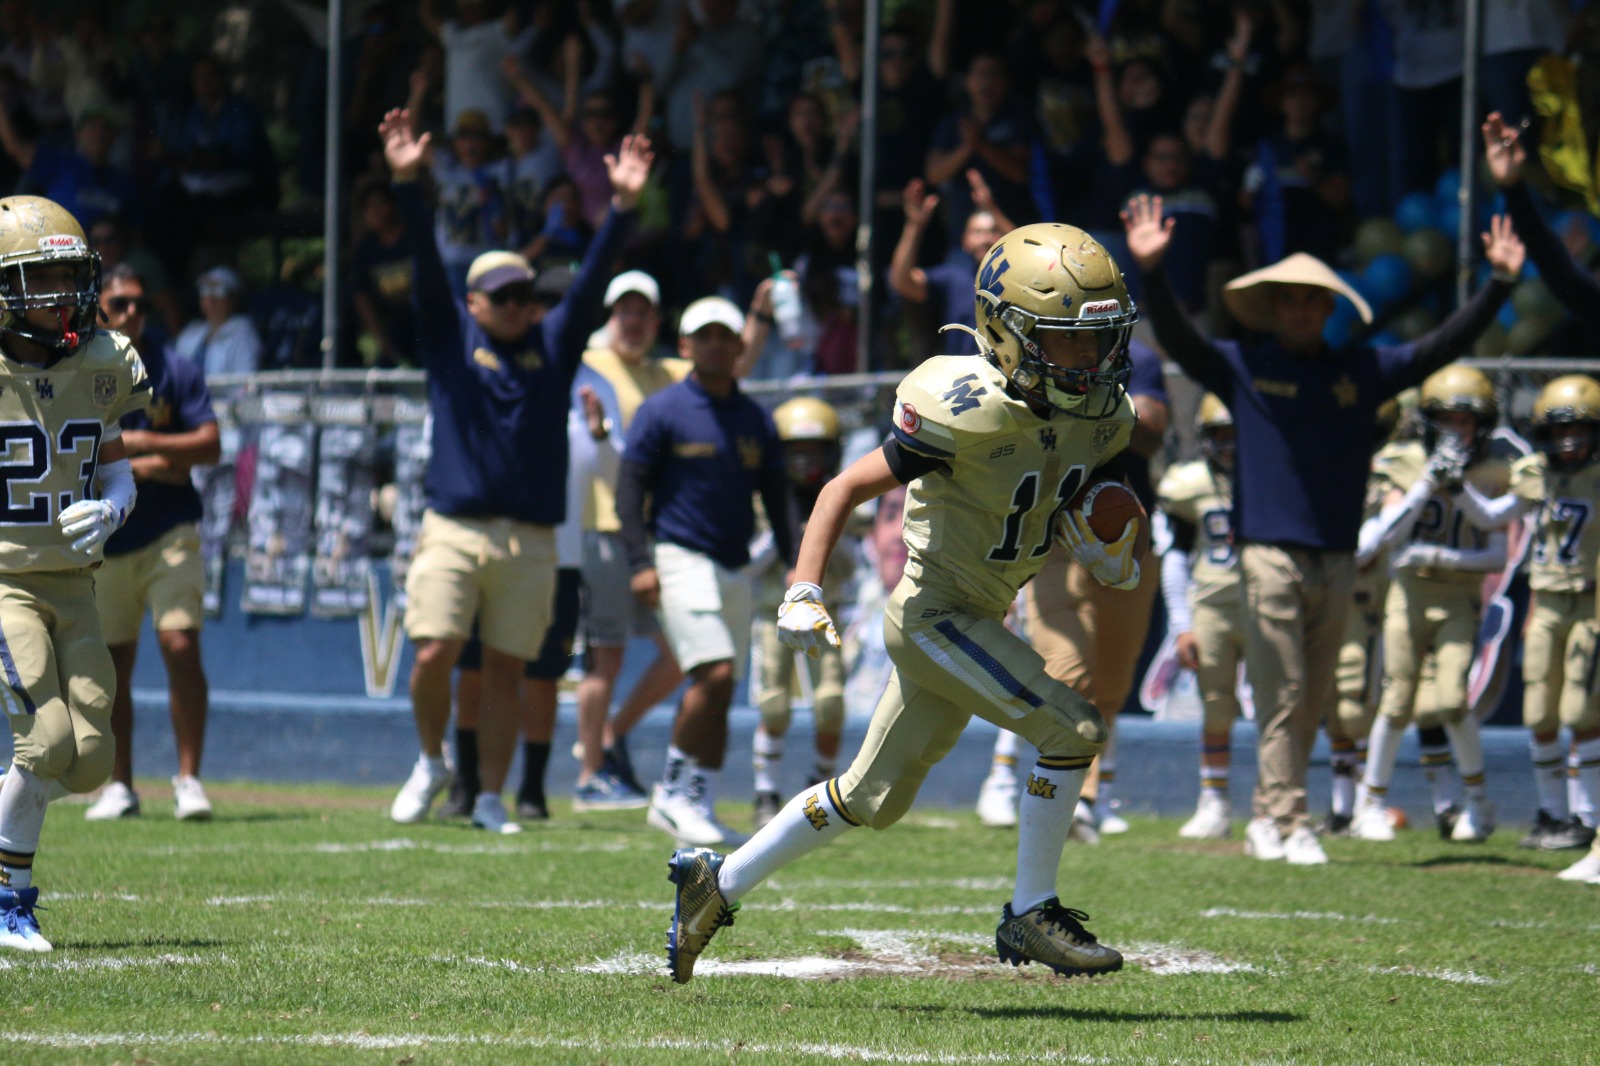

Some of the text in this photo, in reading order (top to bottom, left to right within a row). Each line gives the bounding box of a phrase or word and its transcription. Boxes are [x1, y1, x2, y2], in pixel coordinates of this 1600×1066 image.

[1086, 302, 1119, 314] Riddell
[0, 419, 104, 527] 23
[984, 464, 1087, 563] 11
